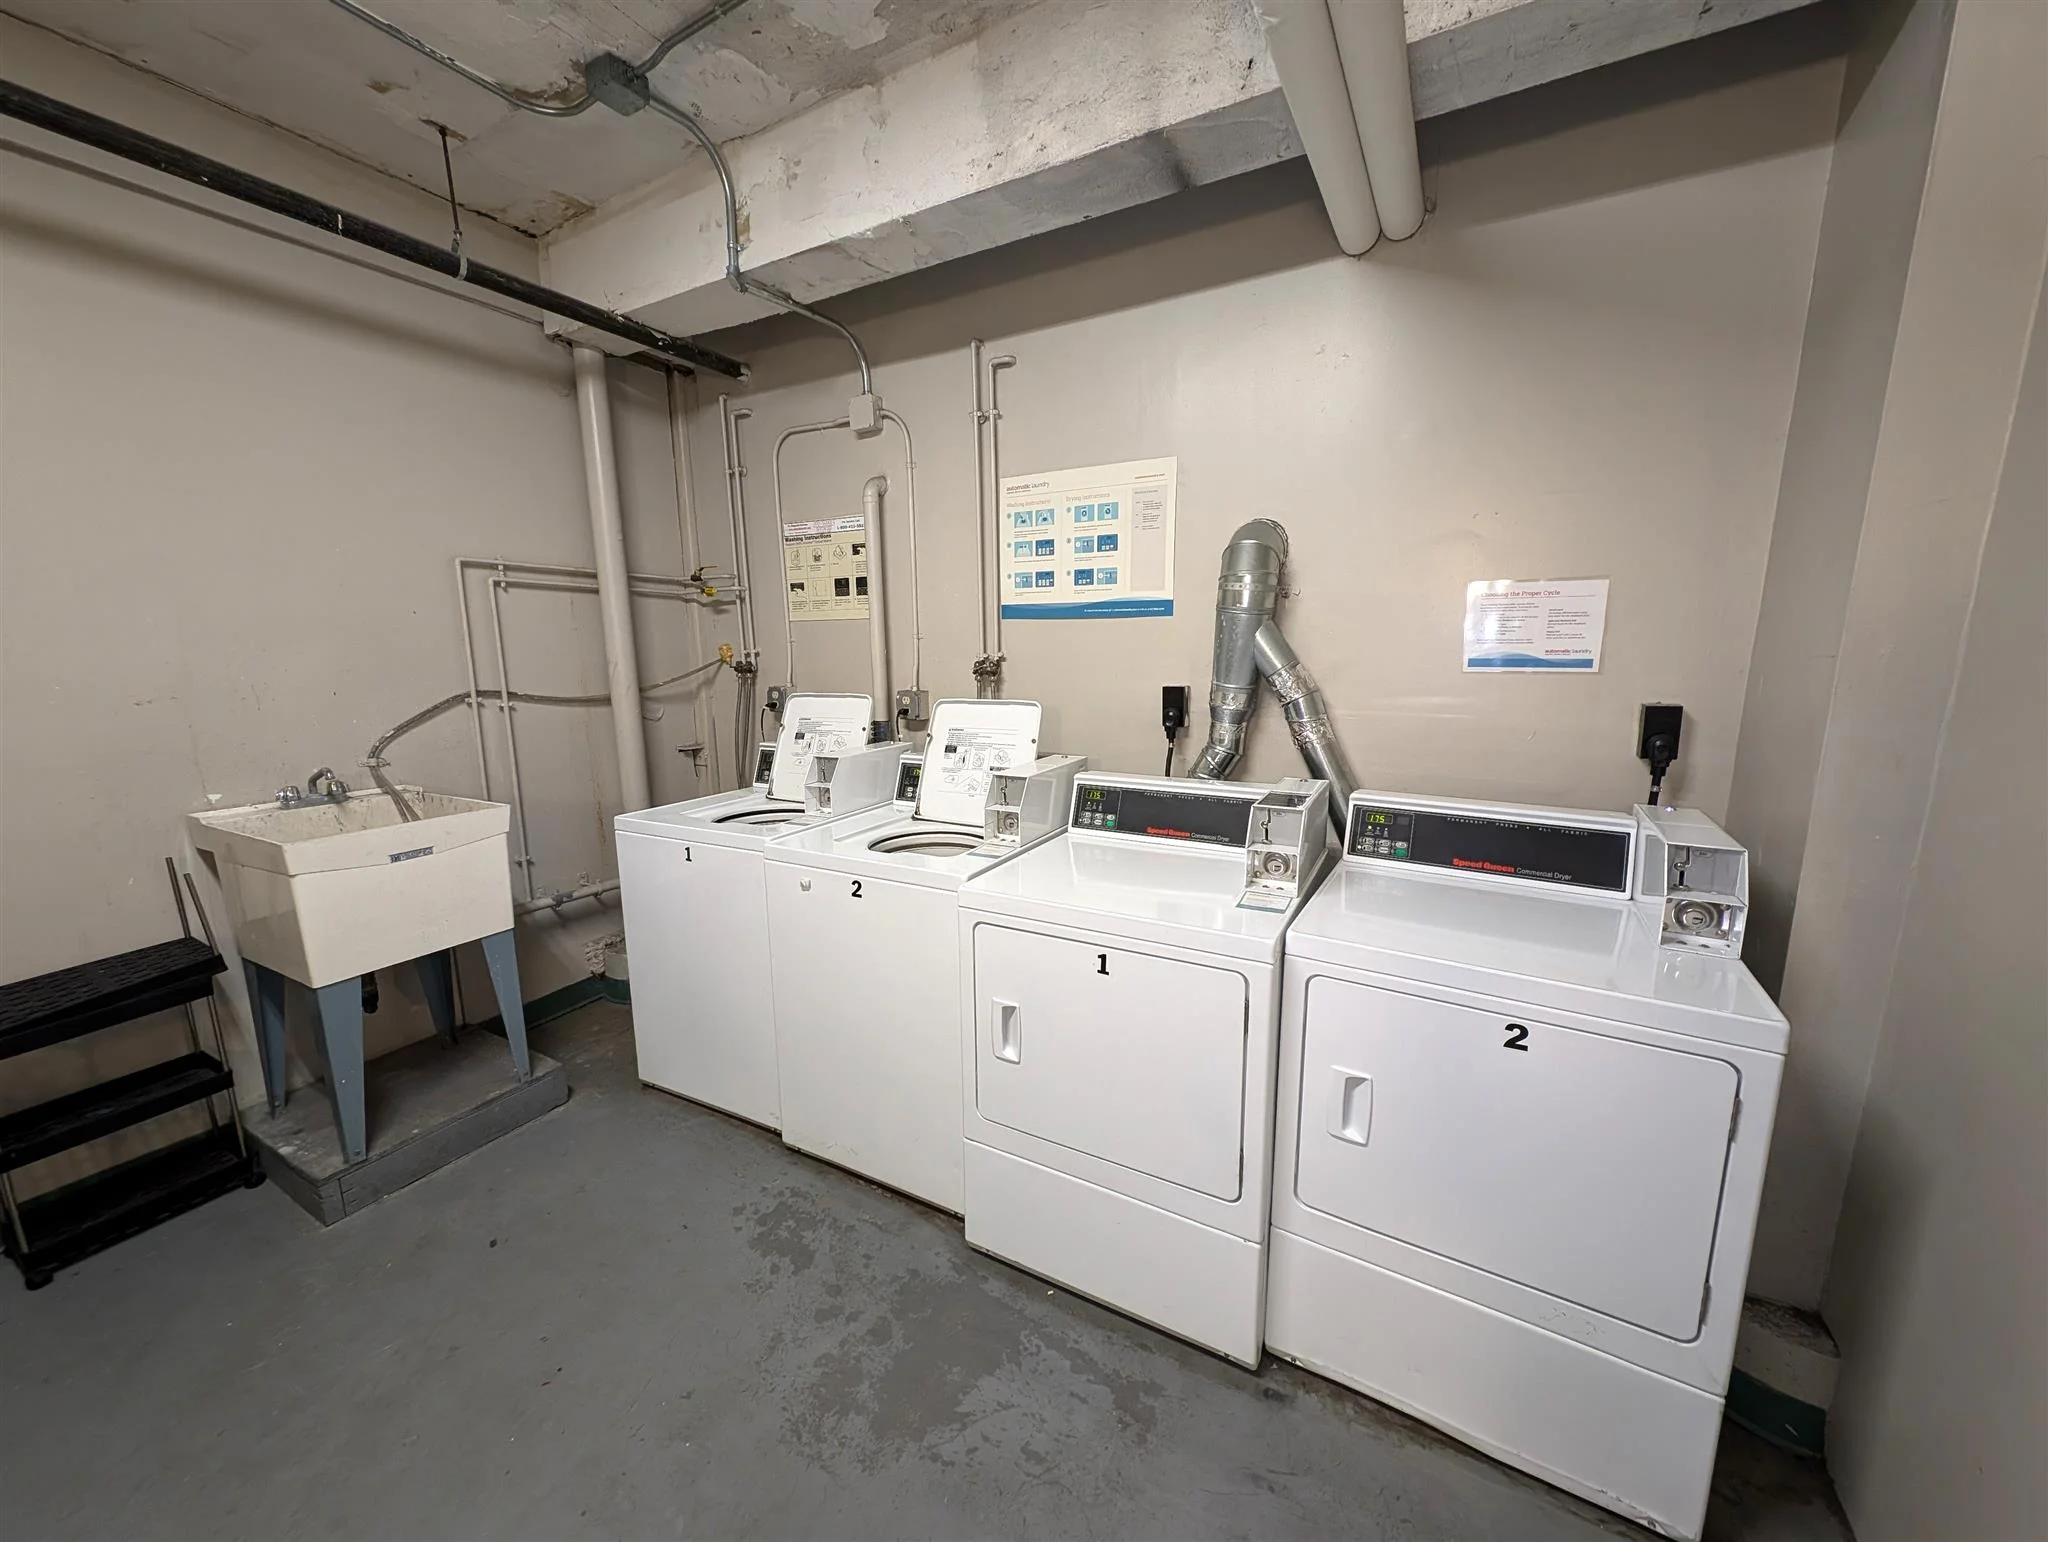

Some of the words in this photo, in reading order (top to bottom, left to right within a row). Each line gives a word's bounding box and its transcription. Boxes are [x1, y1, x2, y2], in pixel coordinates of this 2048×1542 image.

[1006, 483, 1030, 491] automatic
[1031, 481, 1049, 489] laundry
[1521, 590, 1541, 598] Proper
[1147, 826, 1168, 835] Speed
[1168, 828, 1190, 838] Queen
[684, 846, 692, 862] 1
[1452, 857, 1482, 869] Speed
[1483, 861, 1515, 873] Queen
[1516, 867, 1553, 879] Commercial
[1554, 872, 1572, 882] Dryer
[851, 880, 863, 898] 2
[1097, 953, 1109, 976] 1
[1503, 1023, 1529, 1051] 2
